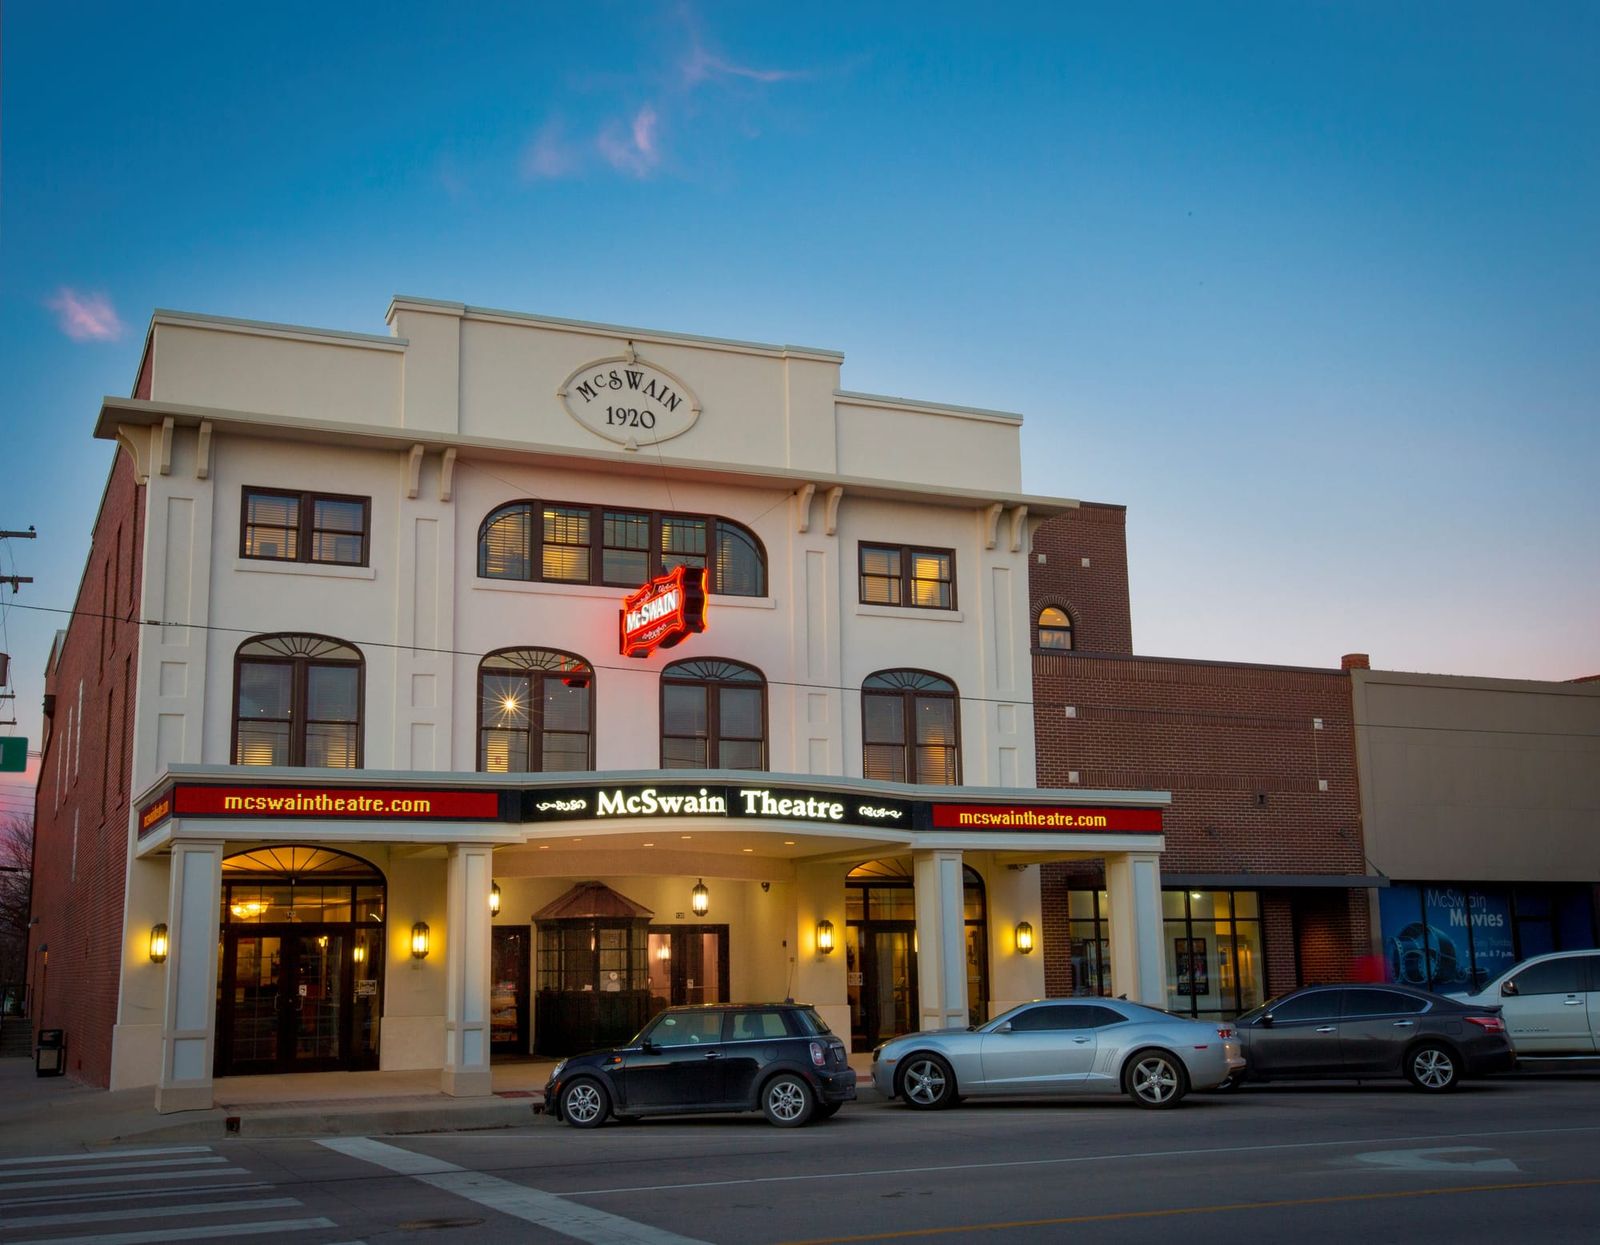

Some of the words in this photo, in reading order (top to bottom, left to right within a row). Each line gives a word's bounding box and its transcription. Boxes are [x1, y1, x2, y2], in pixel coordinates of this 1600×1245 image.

[606, 406, 656, 429] 1920
[224, 793, 430, 812] mcswaintheatre.com
[596, 788, 726, 816] McSwain
[740, 789, 844, 820] Theatre
[959, 810, 1107, 827] mcswaintheatre.com
[1427, 888, 1487, 908] McSwain
[1449, 908, 1504, 927] Movies
